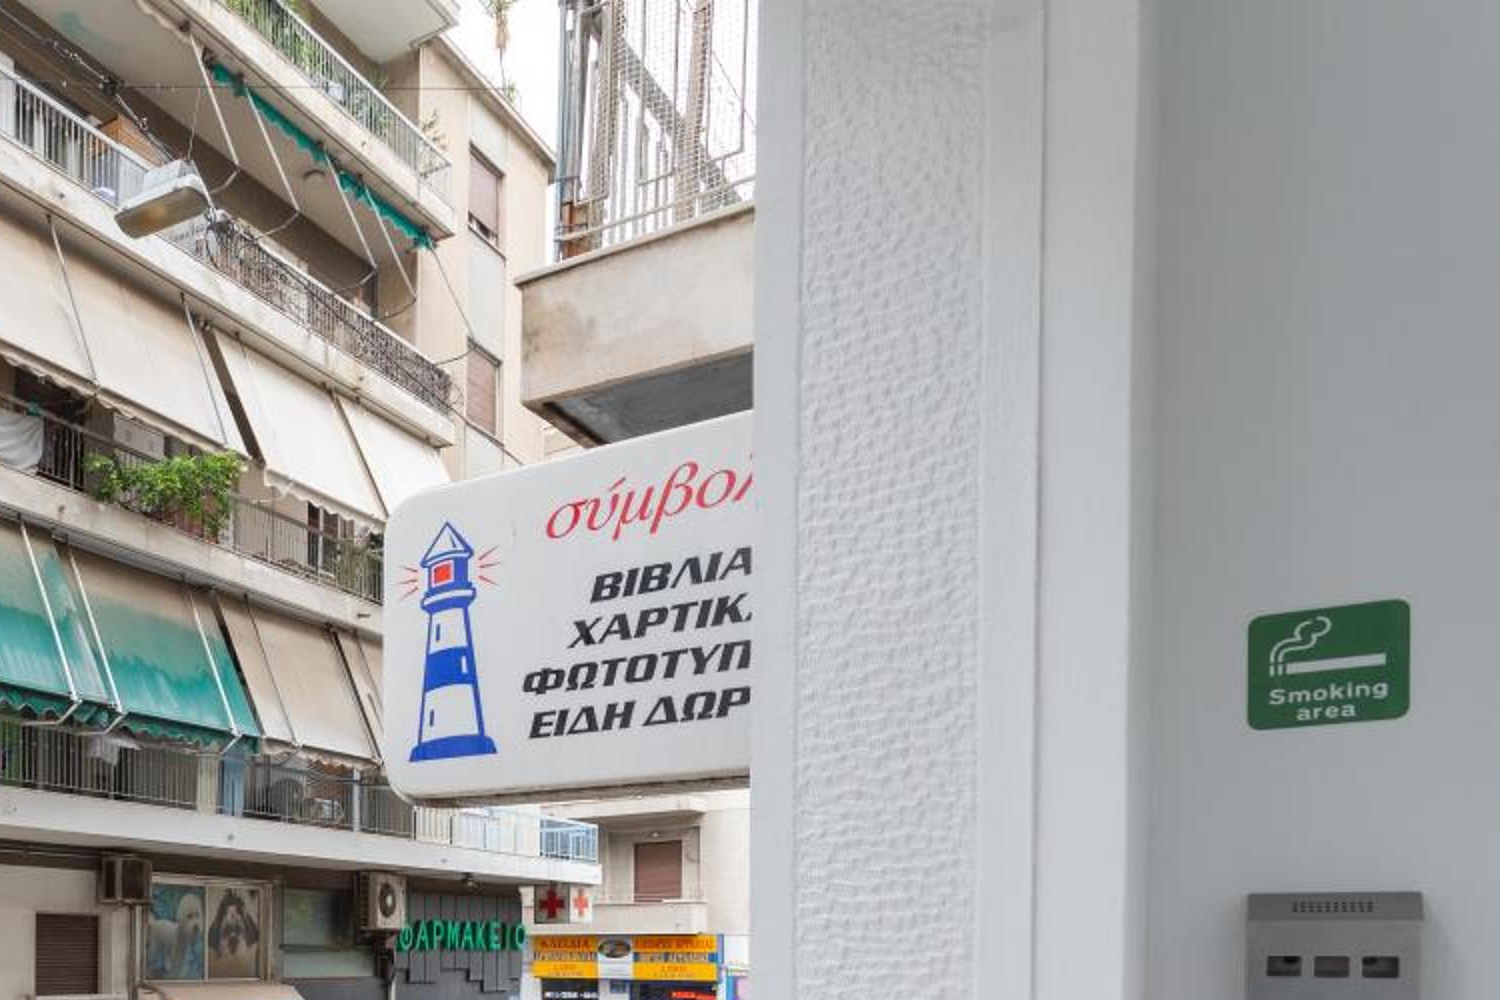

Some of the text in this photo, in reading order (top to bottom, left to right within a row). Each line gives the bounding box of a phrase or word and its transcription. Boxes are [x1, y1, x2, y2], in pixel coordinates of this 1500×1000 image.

[590, 546, 752, 604] ΒΙΒΛΙΑ
[567, 593, 753, 649] ΧΑΡΤΙΚ
[522, 639, 751, 695] ΦΩΤΟΤΥΠ
[1268, 682, 1389, 705] Smoking
[528, 686, 751, 740] ΕΙΔΗ ΔΩΡ
[1296, 704, 1356, 721] area
[397, 919, 526, 952] ΦΑΡΜΑΚΕΙΟ
